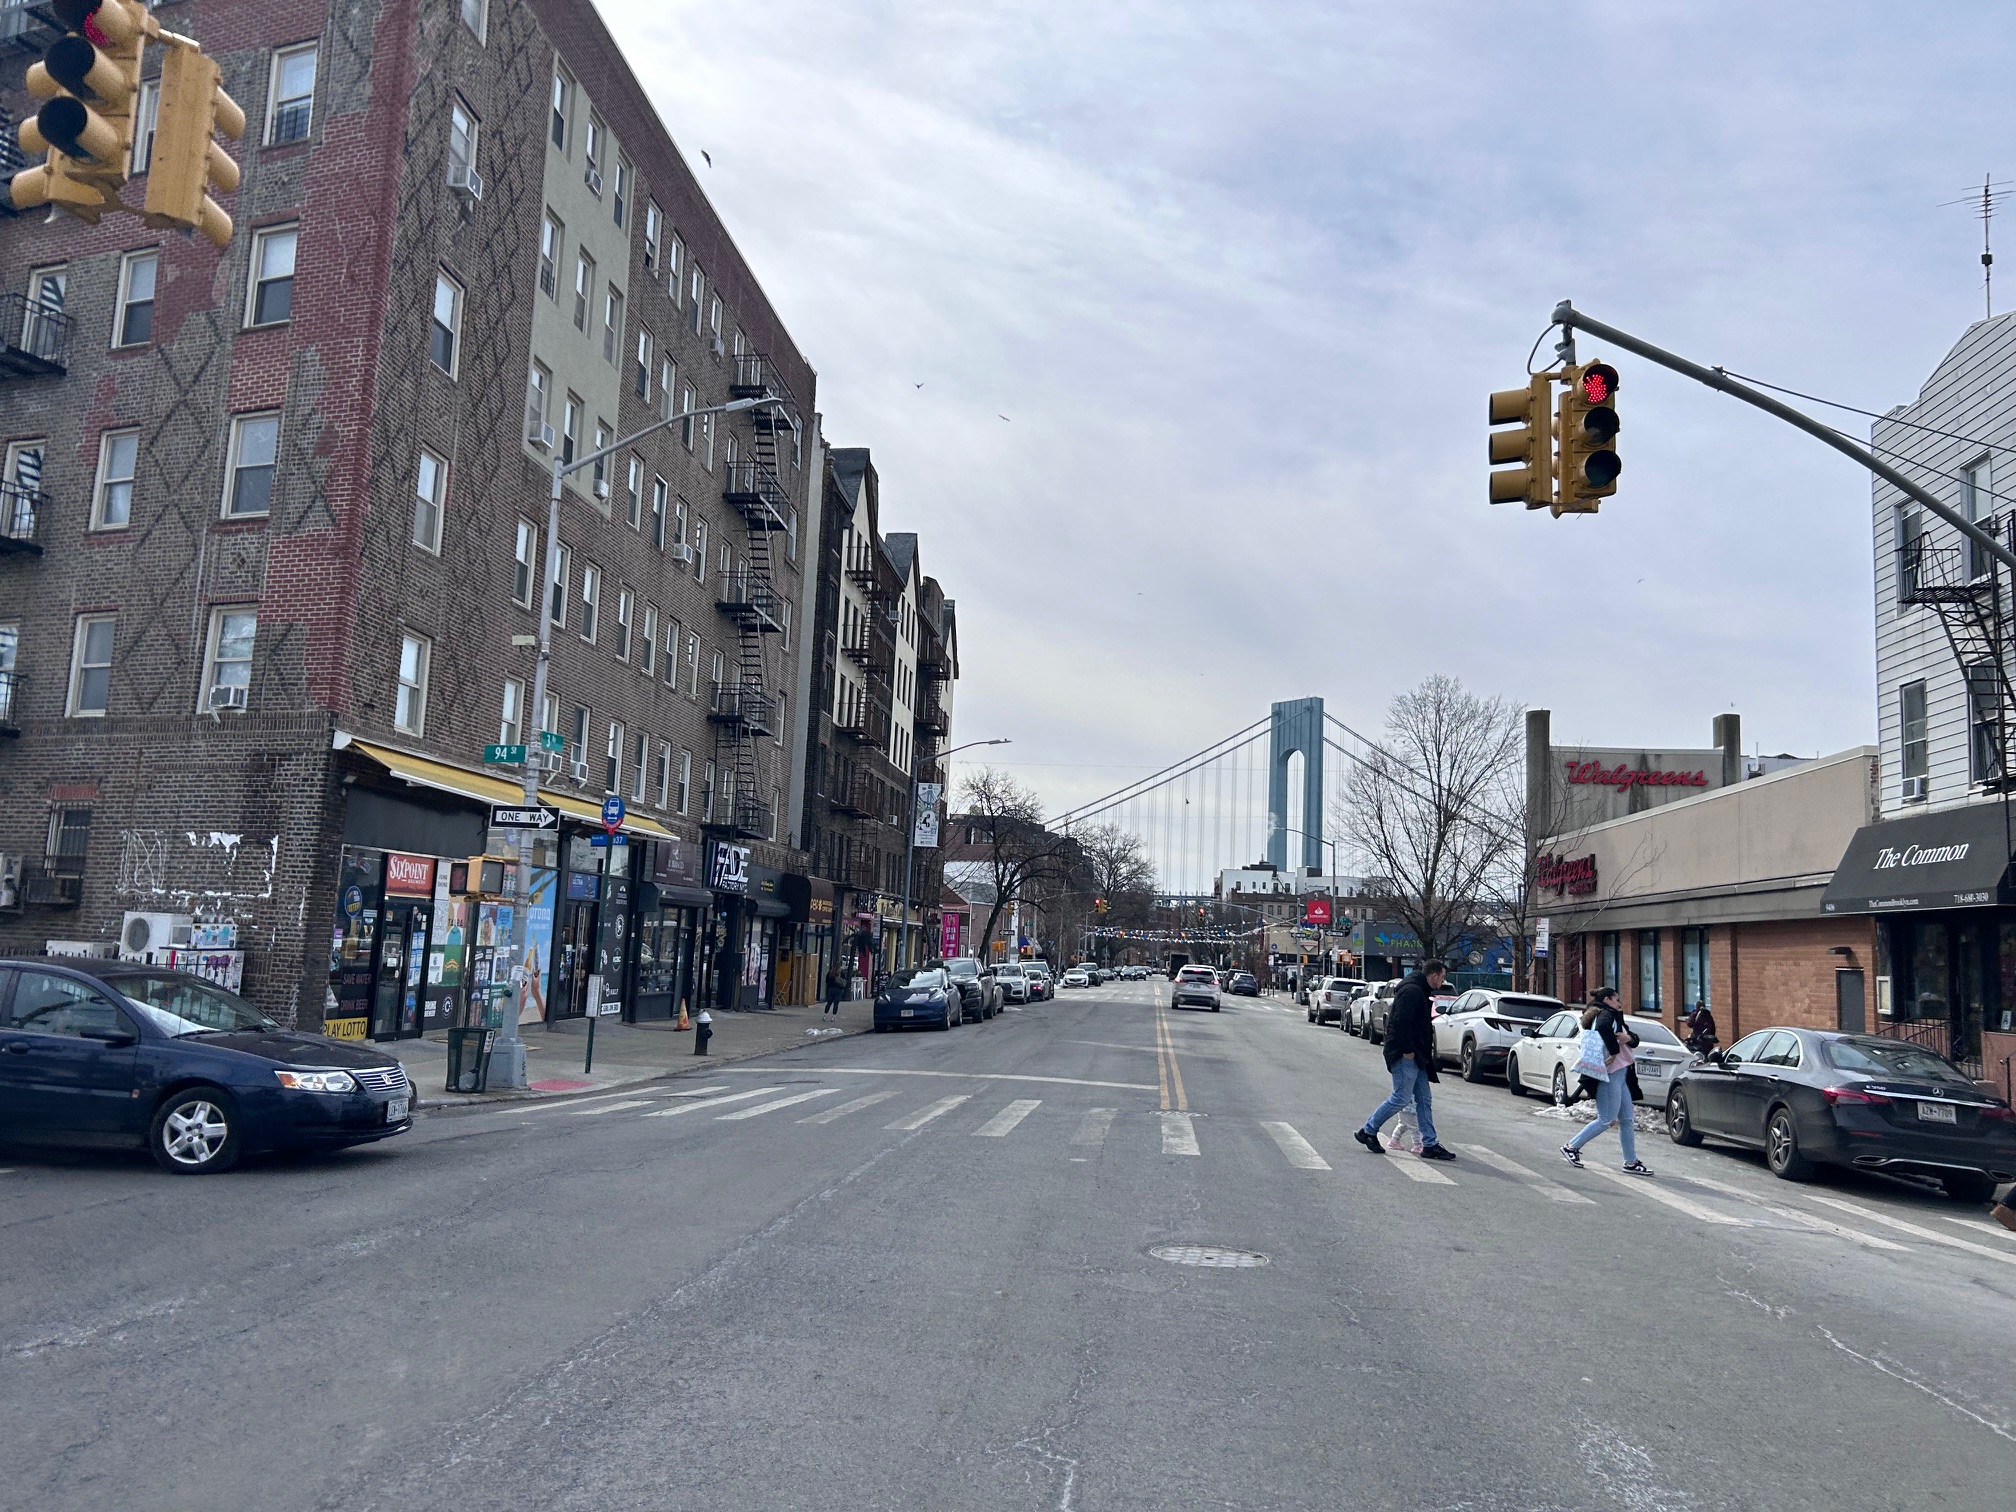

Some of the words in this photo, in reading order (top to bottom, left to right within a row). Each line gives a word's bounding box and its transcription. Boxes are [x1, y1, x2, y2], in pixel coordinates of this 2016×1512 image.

[546, 736, 550, 748] 3
[494, 746, 507, 760] 94
[511, 747, 517, 756] St
[1565, 760, 1709, 793] Walgreens
[501, 812, 521, 821] ONE
[529, 813, 549, 823] WAY
[1873, 847, 1901, 869] The
[1901, 843, 1969, 867] Common
[389, 856, 429, 880] SIXPOINT
[714, 842, 750, 887] FADE
[343, 973, 355, 985] SAVE
[356, 973, 371, 984] WATER
[341, 1000, 355, 1011] DRINK
[356, 999, 368, 1010] BEER
[324, 1022, 340, 1038] PLAY
[342, 1021, 366, 1036] LOTTO
